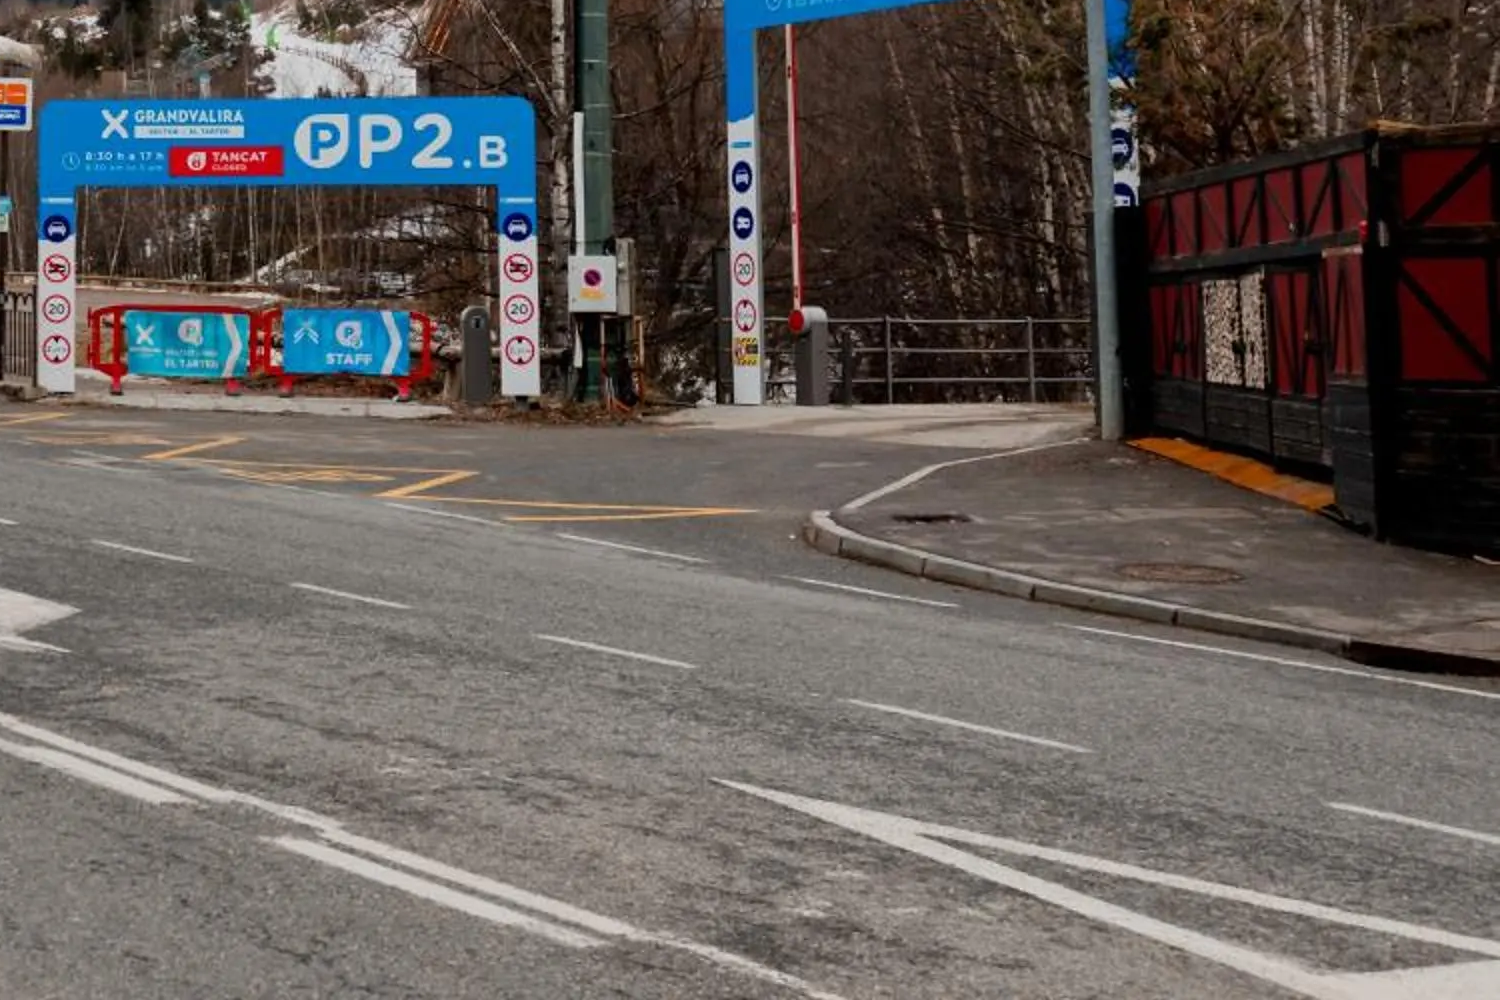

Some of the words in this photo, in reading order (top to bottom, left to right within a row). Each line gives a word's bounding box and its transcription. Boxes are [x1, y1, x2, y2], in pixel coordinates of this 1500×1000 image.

[134, 109, 245, 123] GRANDVALIRA
[85, 151, 113, 161] 8:30
[117, 151, 124, 161] h
[139, 151, 152, 161] 17
[211, 151, 268, 163] TANCAT
[738, 263, 751, 276] 20
[49, 303, 65, 315] 20
[510, 303, 528, 315] 20
[325, 353, 373, 366] STAFF
